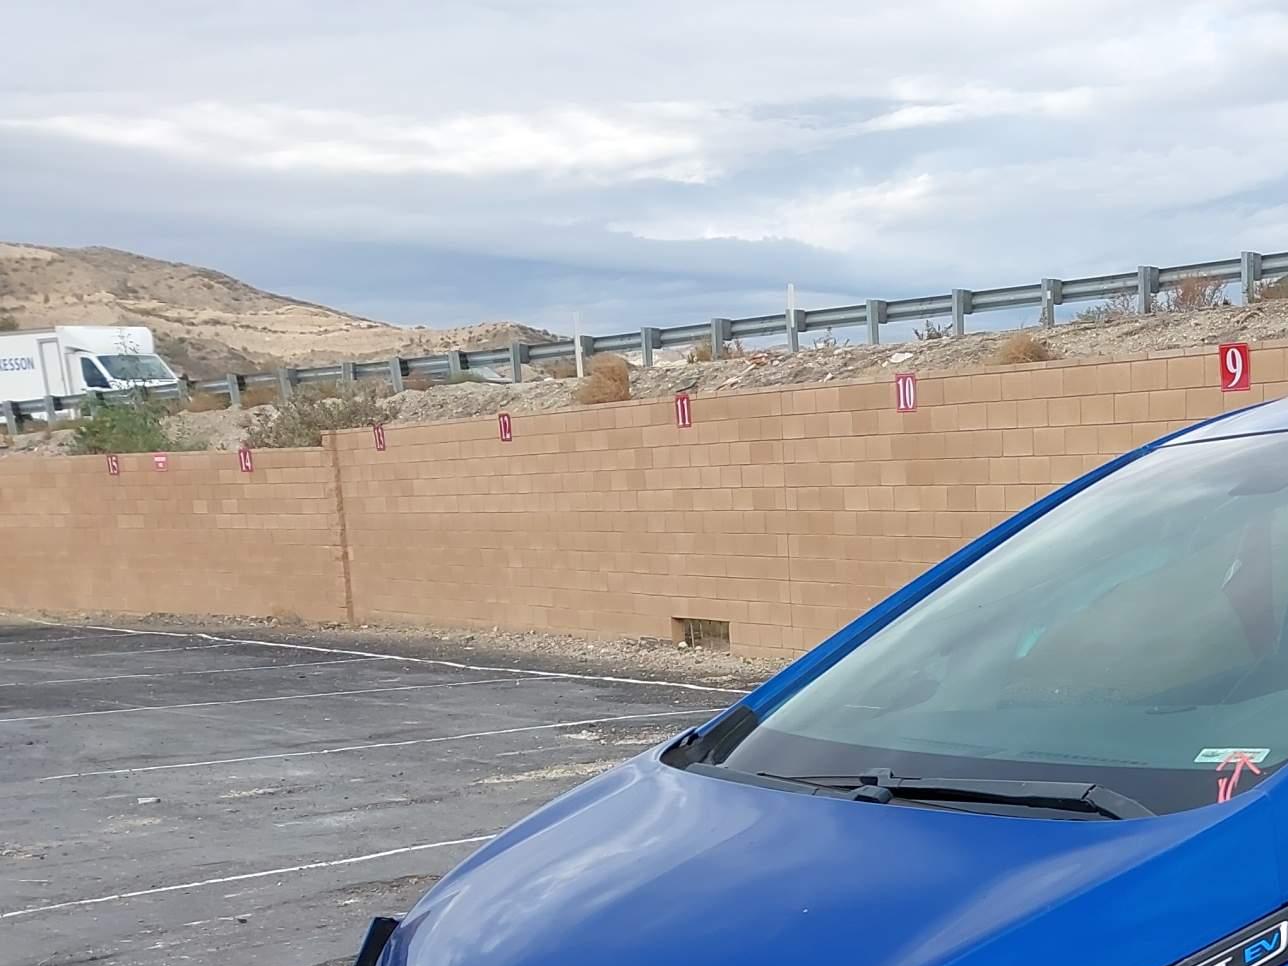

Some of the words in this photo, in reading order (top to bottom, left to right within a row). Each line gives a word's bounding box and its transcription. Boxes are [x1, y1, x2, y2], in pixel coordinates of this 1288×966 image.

[0, 357, 34, 371] ESSON
[1226, 347, 1243, 388] 9
[897, 376, 915, 410] 10
[677, 398, 690, 426] 11
[106, 456, 118, 474] 15
[240, 451, 252, 472] 14
[1243, 932, 1280, 964] EV
